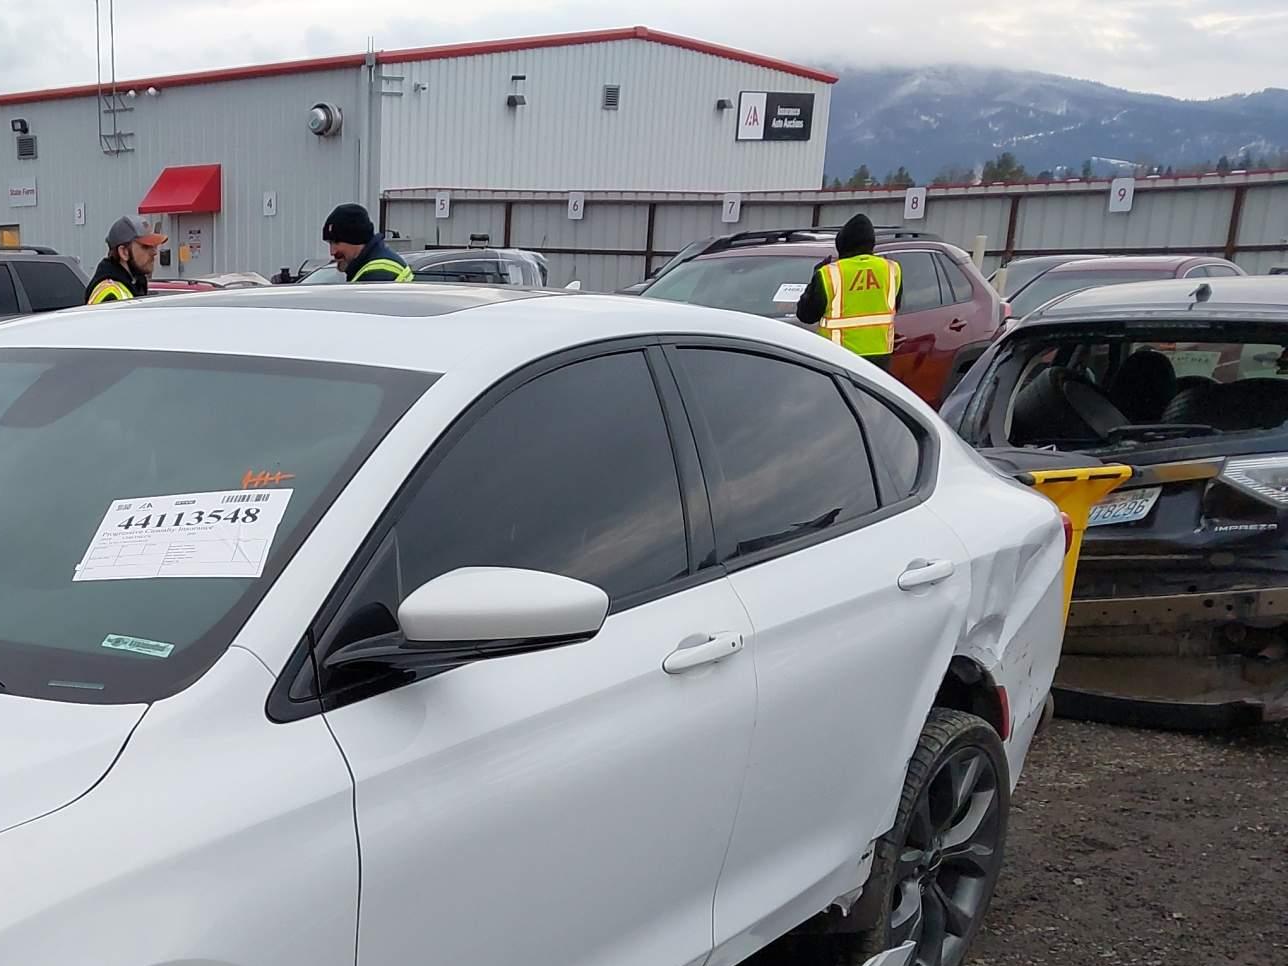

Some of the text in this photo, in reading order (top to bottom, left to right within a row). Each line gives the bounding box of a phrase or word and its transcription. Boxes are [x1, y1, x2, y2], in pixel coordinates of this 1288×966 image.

[772, 117, 783, 128] Auto
[9, 187, 35, 196] State Farm
[1118, 187, 1127, 202] 9
[266, 198, 273, 209] 4
[439, 199, 446, 211] 5
[572, 200, 579, 212] 6
[728, 201, 736, 215] 7
[911, 196, 919, 210] 8
[76, 208, 82, 218] 3
[118, 507, 261, 530] 44113548
[178, 525, 214, 533] Insurance
[1214, 523, 1278, 533] IMPREZA
